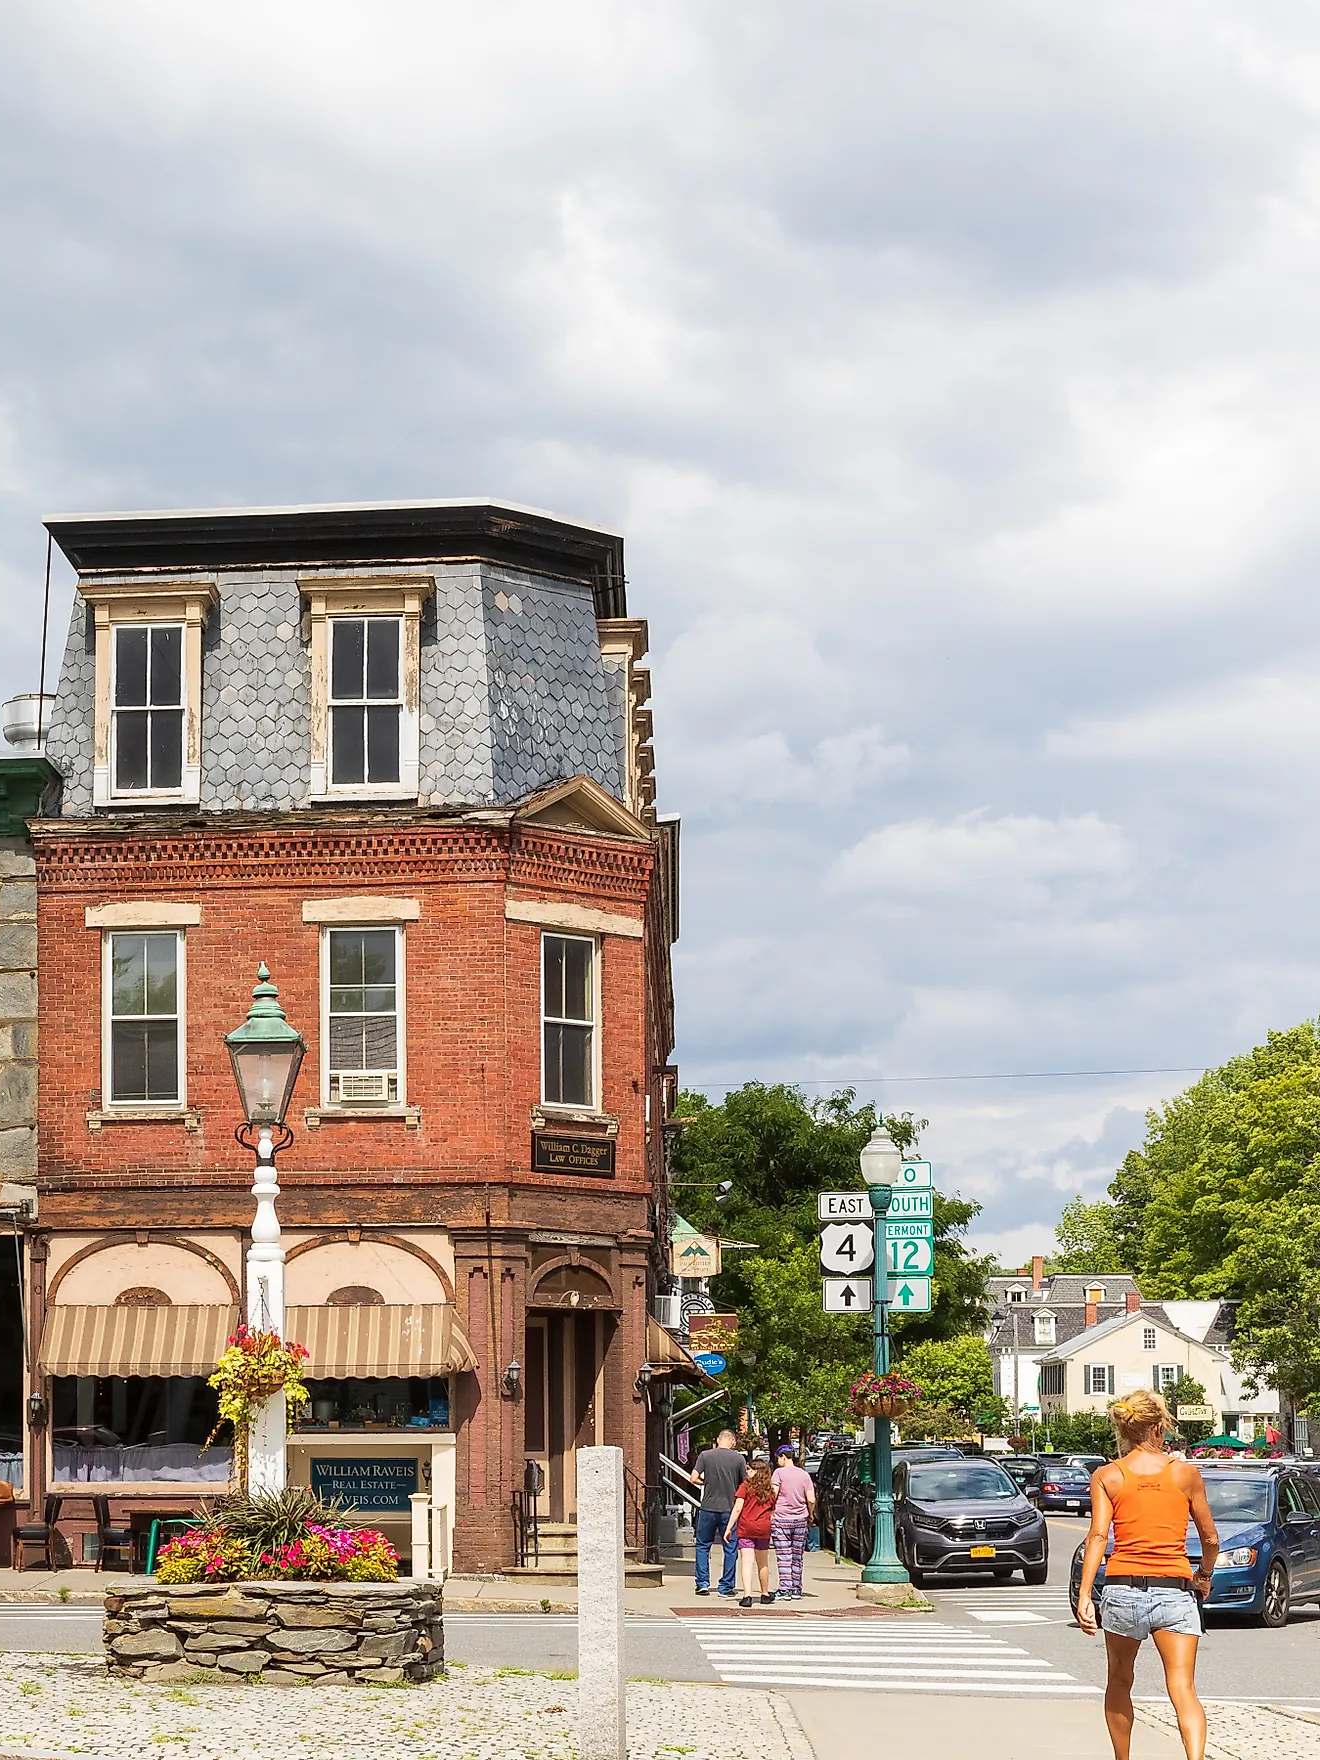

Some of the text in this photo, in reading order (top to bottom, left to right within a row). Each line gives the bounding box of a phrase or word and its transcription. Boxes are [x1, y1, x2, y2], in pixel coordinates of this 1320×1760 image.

[540, 1141, 608, 1158] William C. Dagger
[549, 1153, 599, 1166] LAW OFFICES
[828, 1197, 864, 1213] EAST
[891, 1197, 929, 1212] OUTH
[886, 1225, 928, 1236] ERMONT
[835, 1233, 857, 1262] 4
[891, 1240, 919, 1270] 12
[315, 1464, 415, 1477] WILLIAM RAVEIS
[332, 1480, 397, 1490] REAL ESTATE
